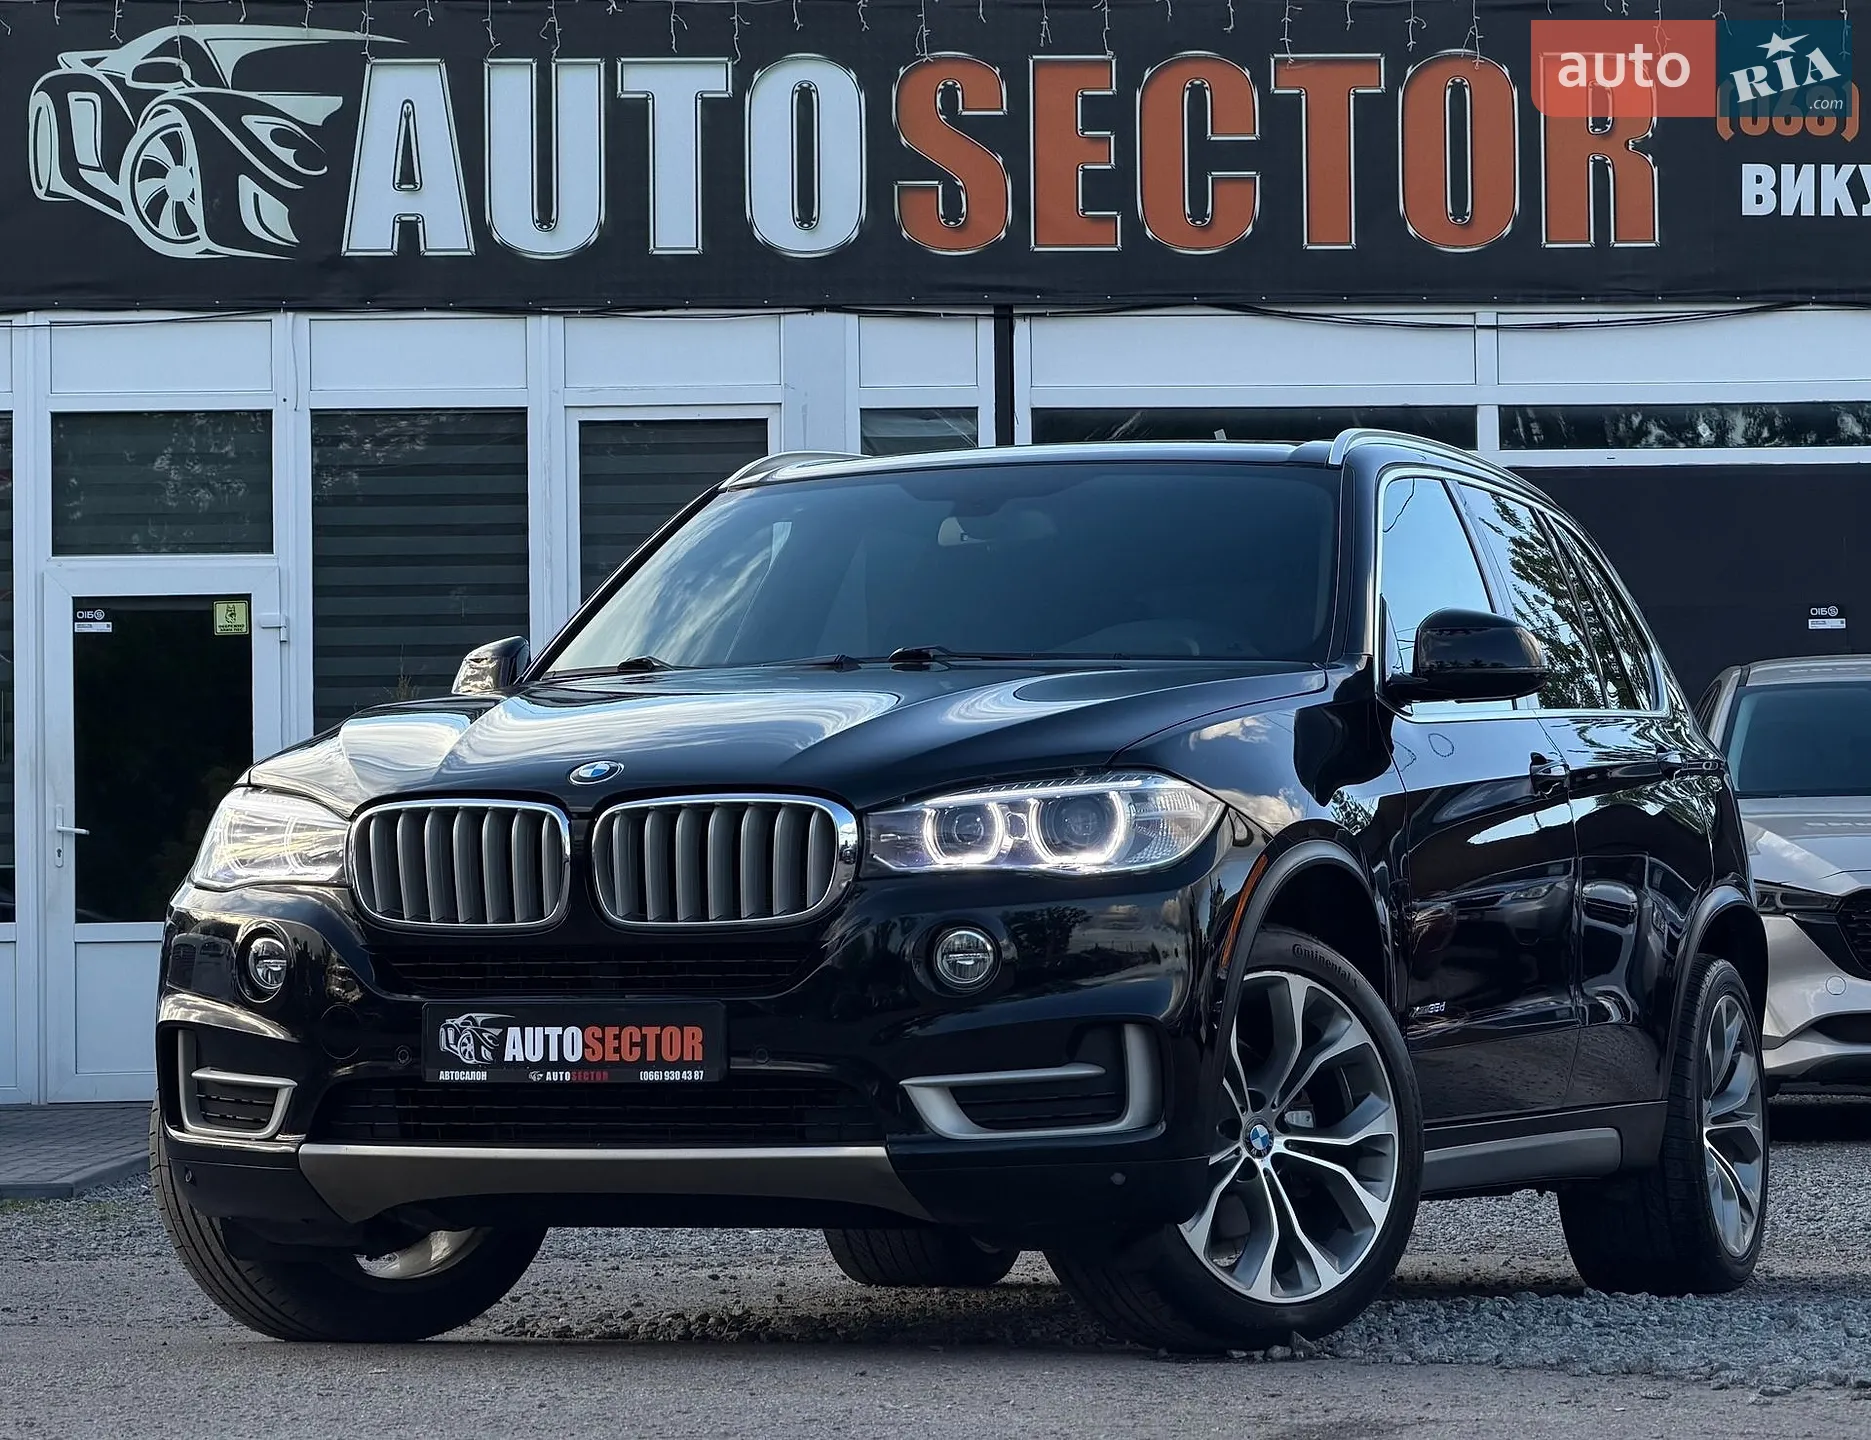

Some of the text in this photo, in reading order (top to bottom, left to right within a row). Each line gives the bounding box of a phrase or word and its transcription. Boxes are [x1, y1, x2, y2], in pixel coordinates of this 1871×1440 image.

[340, 52, 1660, 258] AUTOSECTOR
[504, 1026, 704, 1062] AUTOSECTOR
[439, 1070, 488, 1081] АВТОСАЛОН
[639, 1070, 704, 1081] (066) 930 43 87
